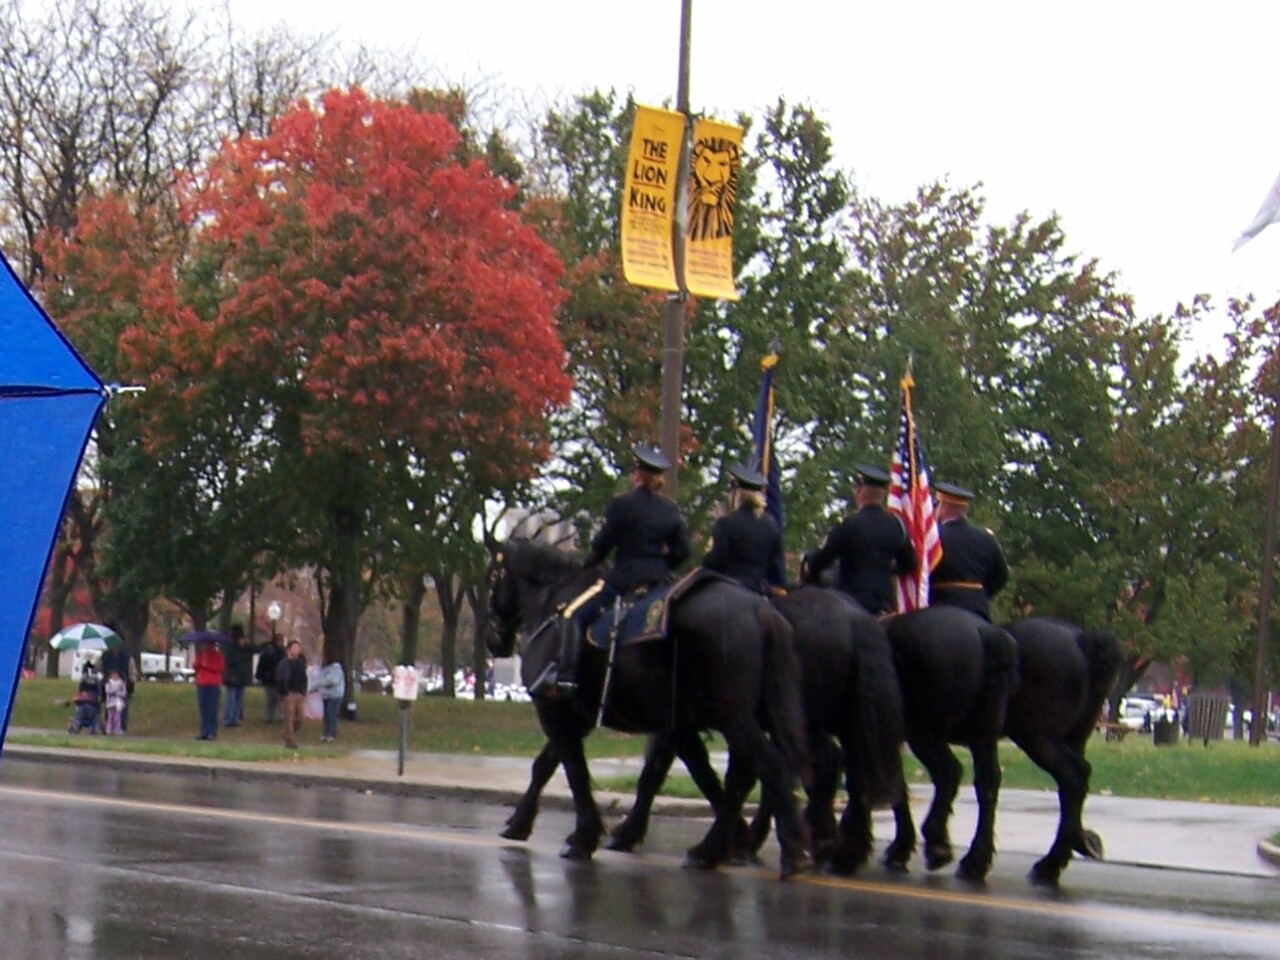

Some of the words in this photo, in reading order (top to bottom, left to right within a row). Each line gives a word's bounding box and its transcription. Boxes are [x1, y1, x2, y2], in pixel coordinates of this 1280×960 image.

[643, 138, 668, 160] THE
[633, 160, 668, 186] LION
[629, 187, 667, 214] KING
